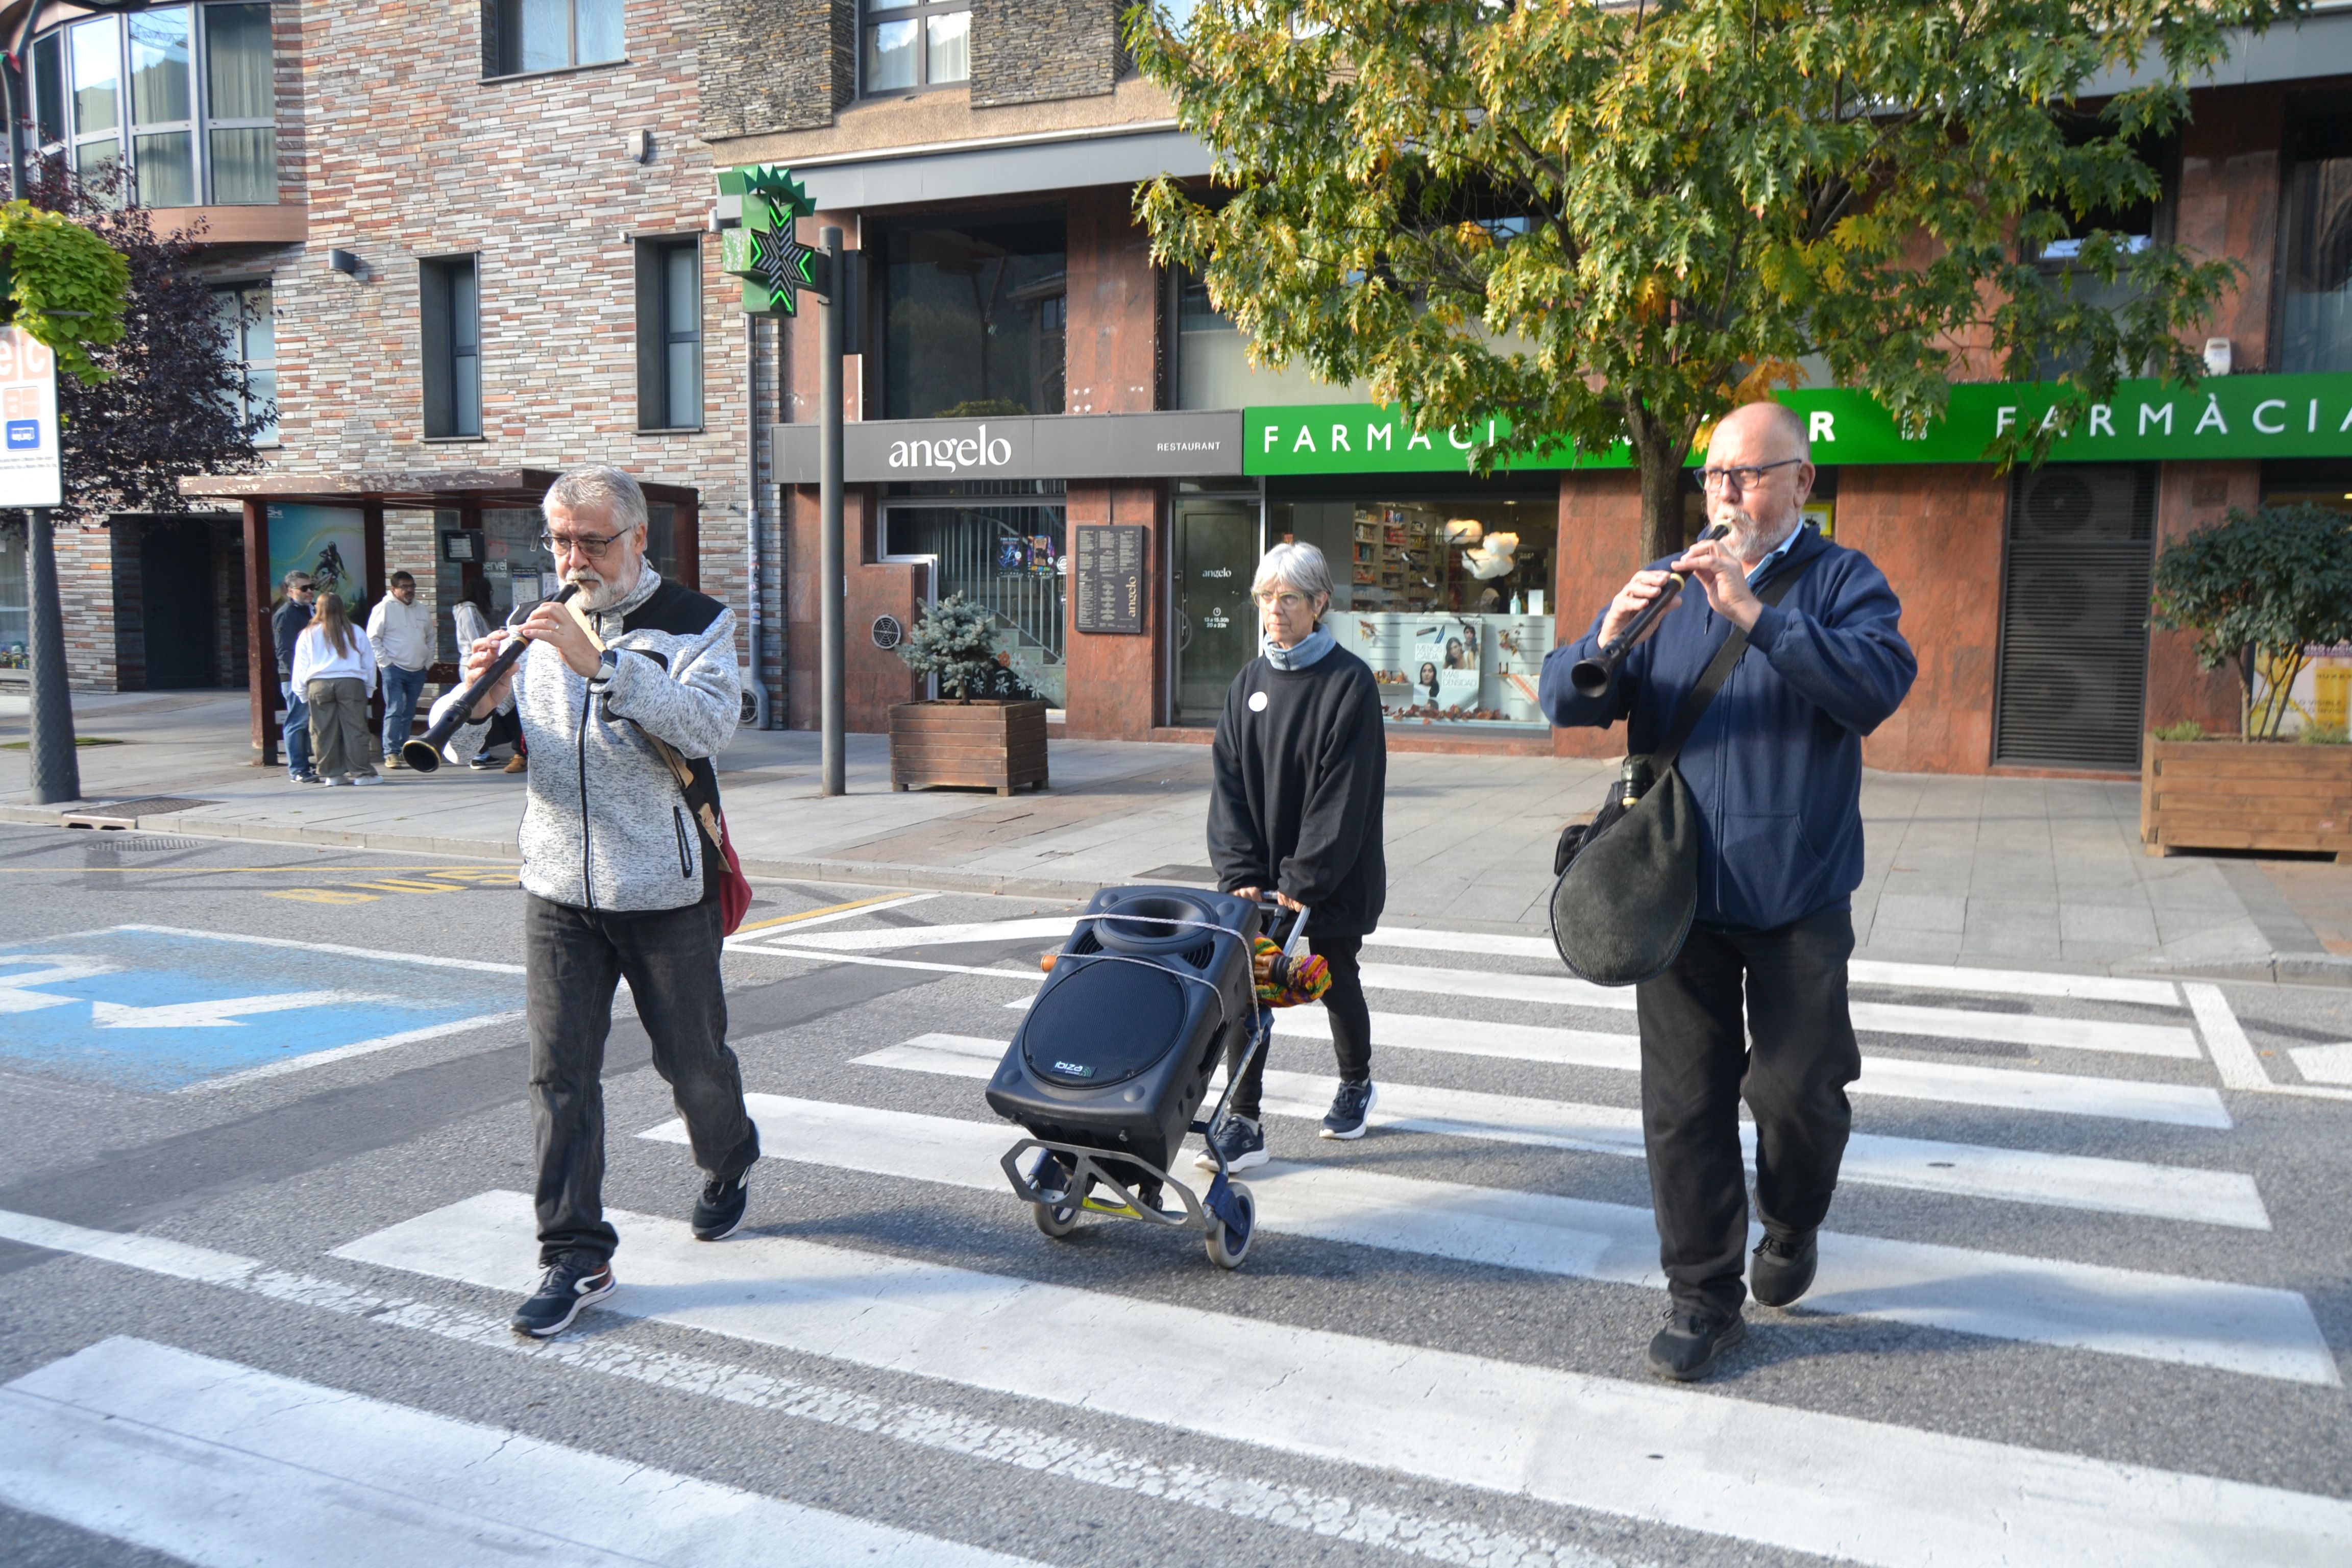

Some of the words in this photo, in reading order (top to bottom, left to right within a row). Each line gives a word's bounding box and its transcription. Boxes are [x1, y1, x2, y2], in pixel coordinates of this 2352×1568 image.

[889, 424, 1012, 473] angelo
[1157, 442, 1220, 452] RESTAURANT
[1202, 567, 1232, 578] angelo
[1125, 576, 1137, 618] angelo
[1055, 1061, 1083, 1072] ibiza
